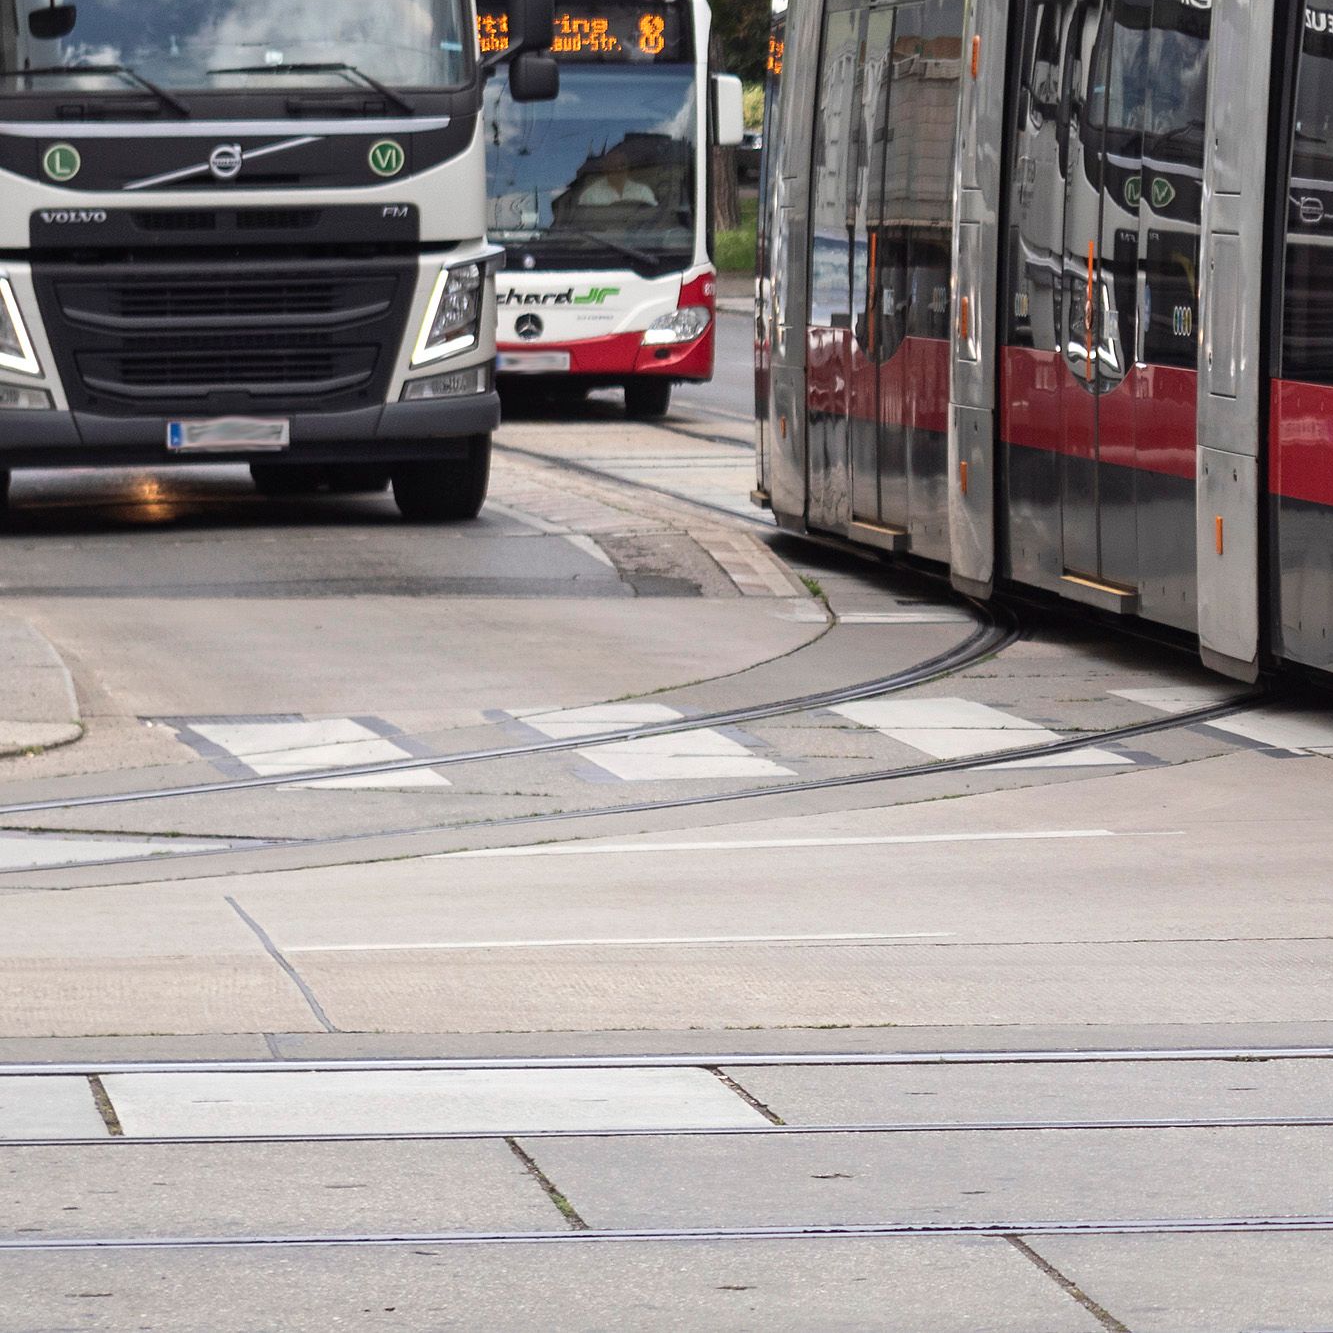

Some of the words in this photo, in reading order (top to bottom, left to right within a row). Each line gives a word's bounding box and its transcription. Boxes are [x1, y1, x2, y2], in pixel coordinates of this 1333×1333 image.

[54, 150, 69, 174] L
[374, 149, 397, 169] VI
[40, 209, 107, 224] VOLVO
[382, 206, 409, 218] FM
